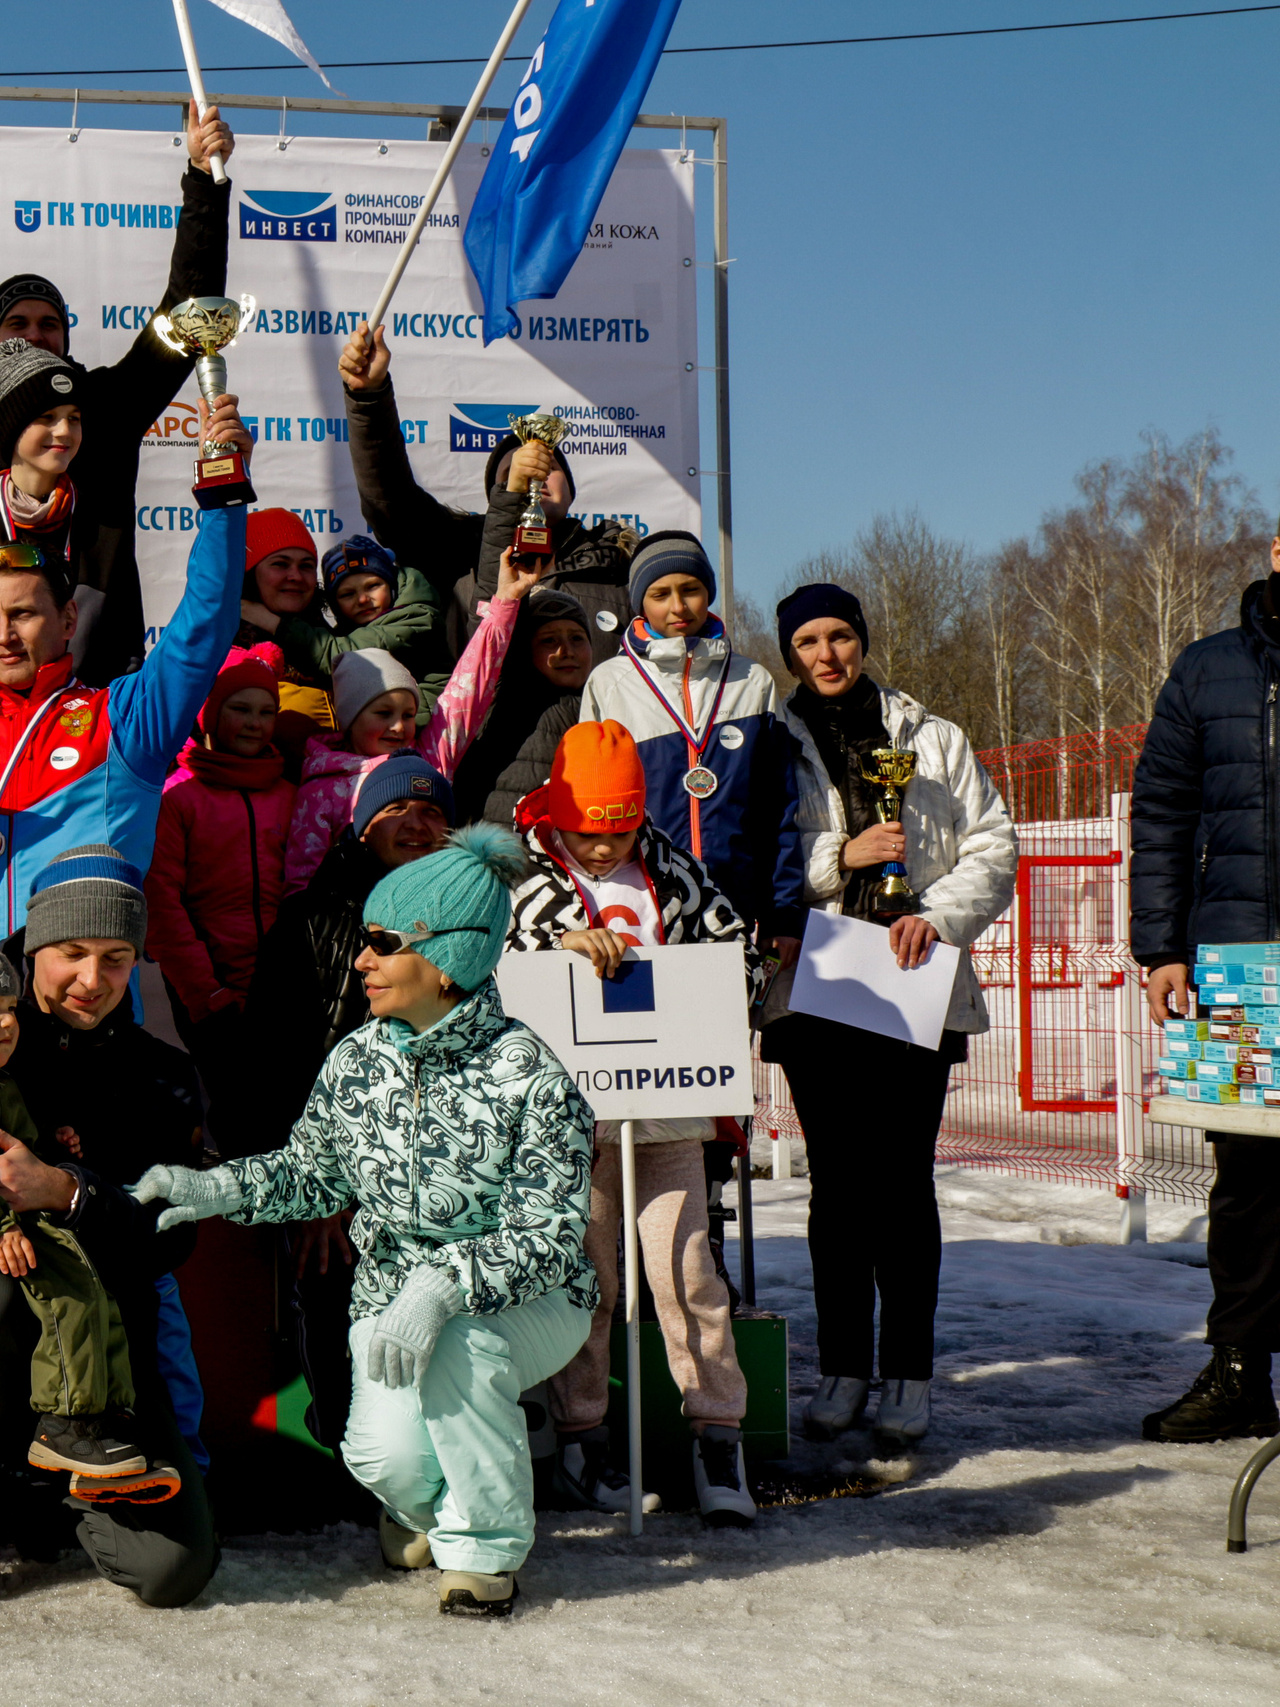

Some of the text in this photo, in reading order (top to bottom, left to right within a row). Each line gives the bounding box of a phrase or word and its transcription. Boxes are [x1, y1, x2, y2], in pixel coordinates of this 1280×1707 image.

[47, 201, 75, 226] ГК
[245, 220, 331, 237] ИНВЕСТ
[609, 223, 660, 240] КОЖА
[528, 315, 650, 343] ИЗМЕРЯТЬ
[552, 405, 640, 420] ФИНАНСОВО-
[265, 417, 291, 441] ГК
[157, 439, 199, 448] КОМПАНИЙ
[576, 1065, 735, 1092] ЛОПРИБОР
